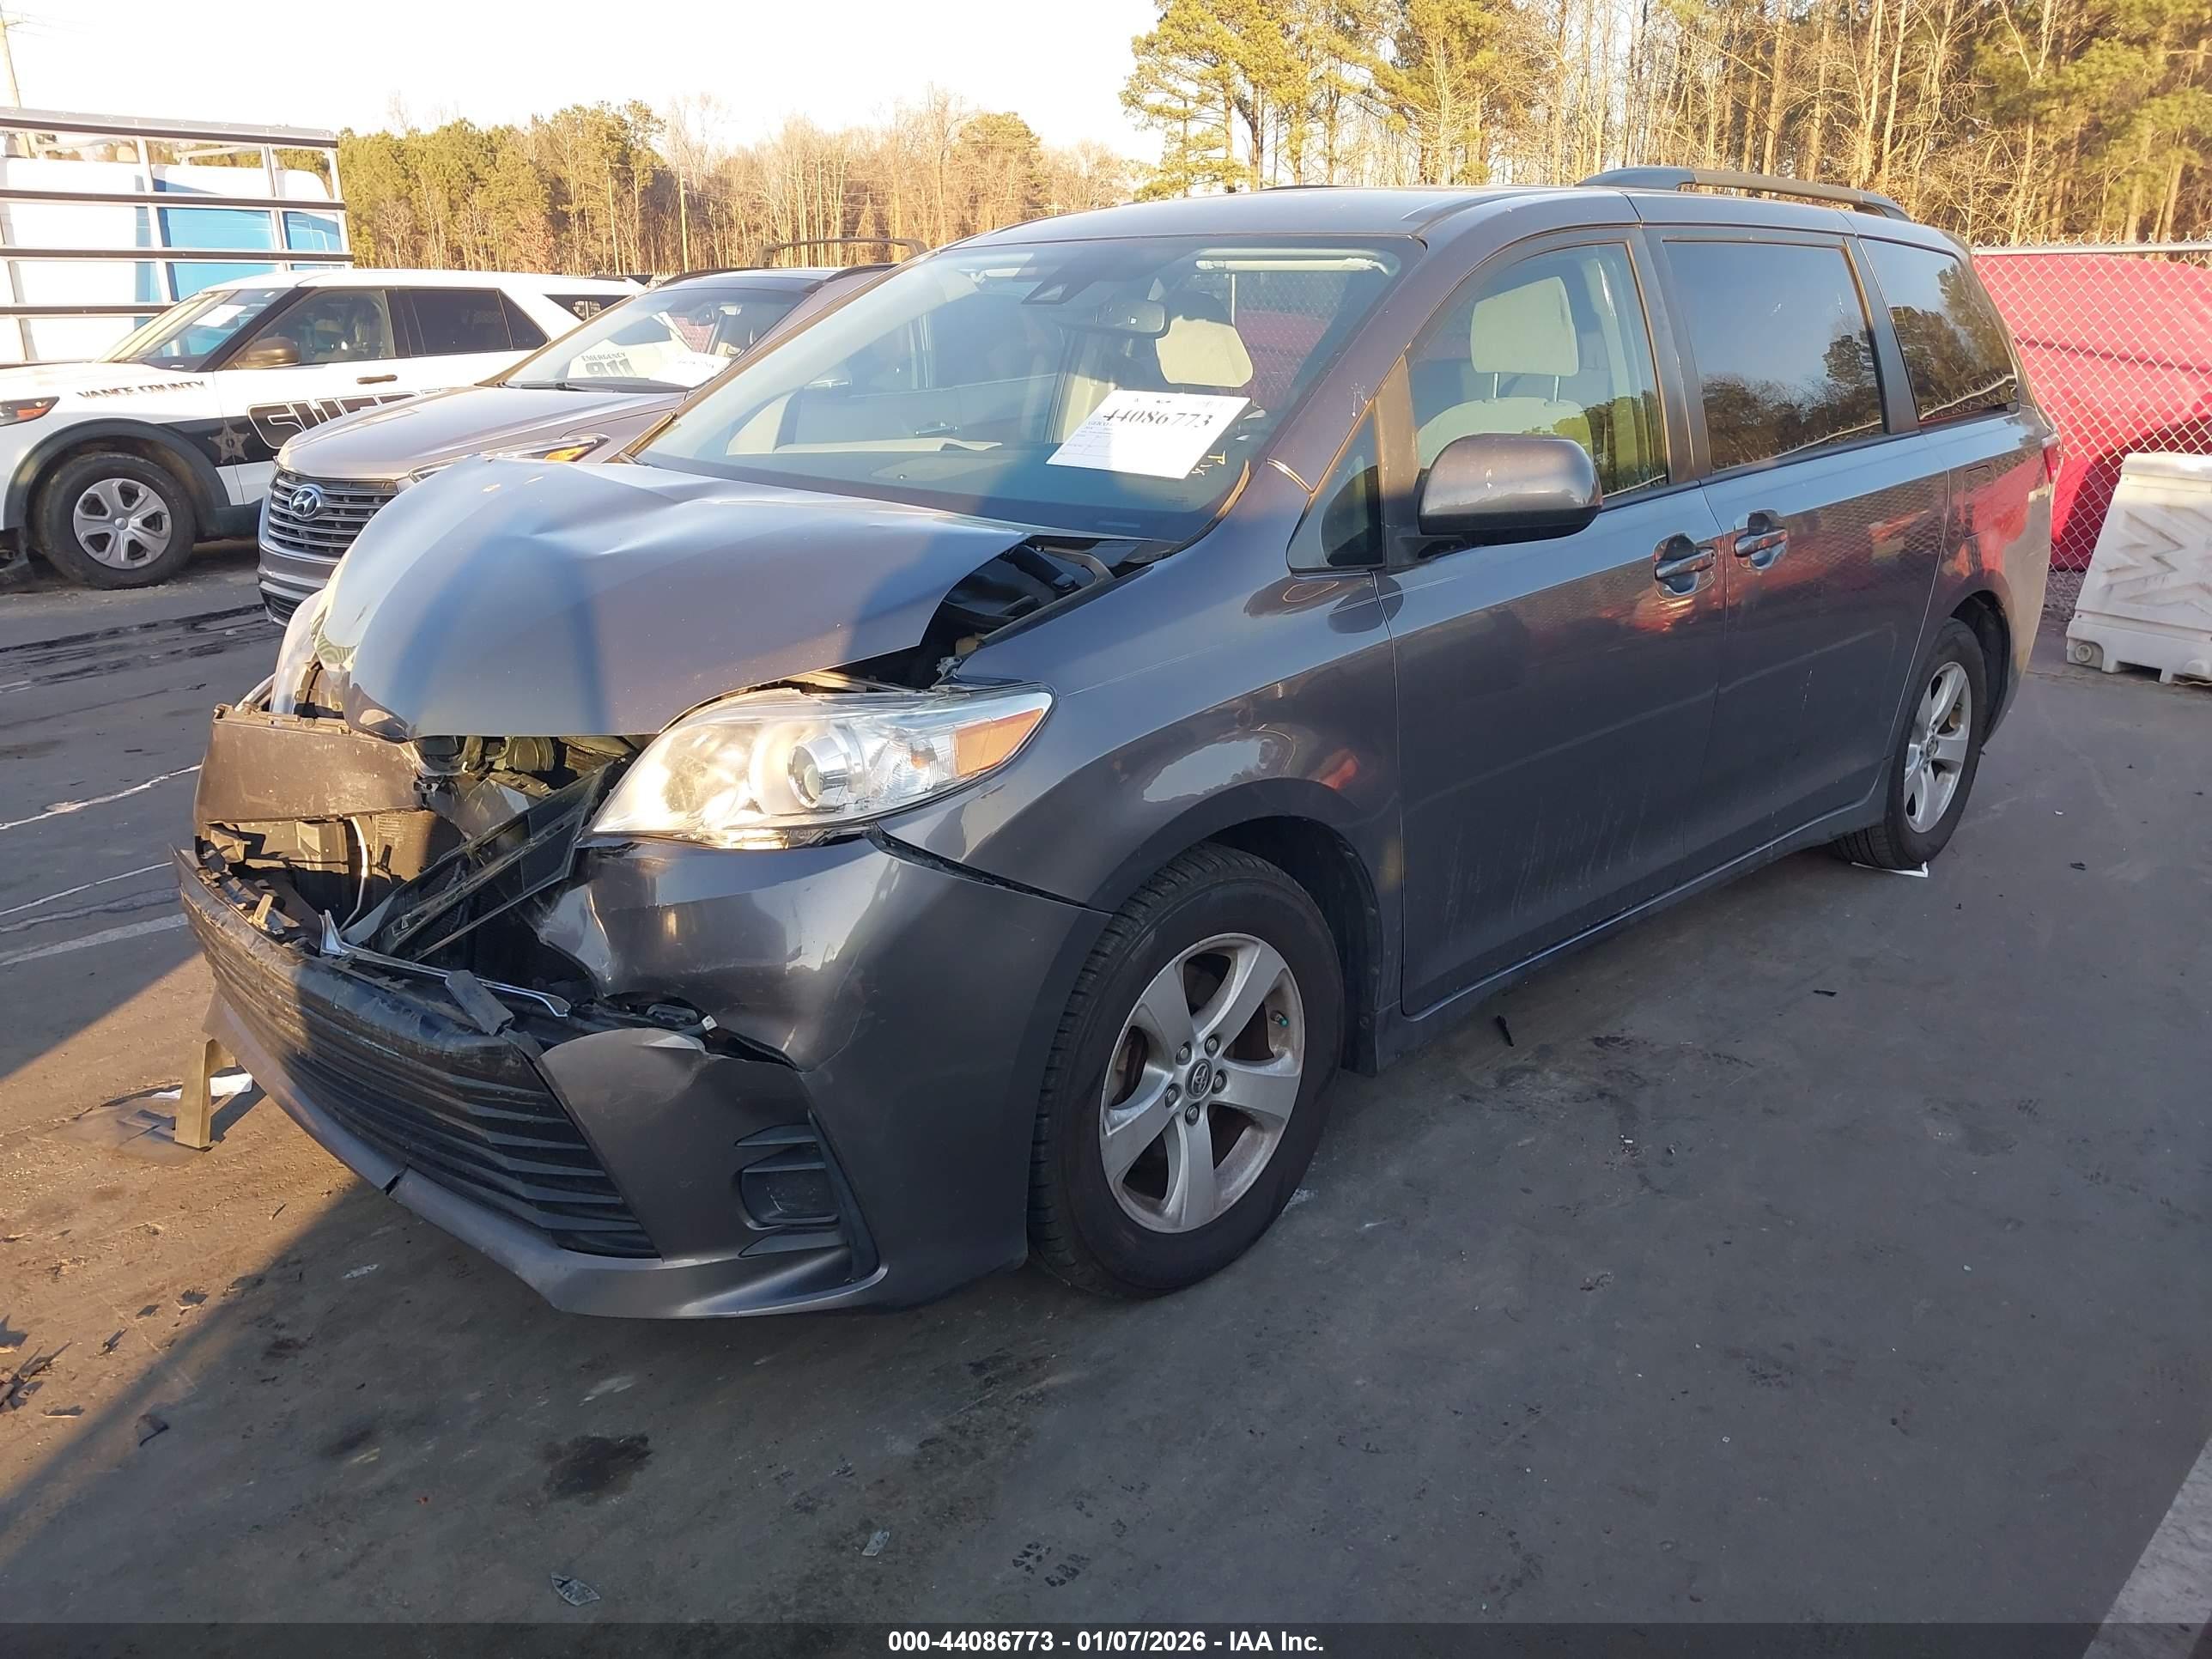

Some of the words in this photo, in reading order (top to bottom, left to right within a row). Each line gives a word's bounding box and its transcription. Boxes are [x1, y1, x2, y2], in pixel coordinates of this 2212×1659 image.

[585, 357, 636, 377] 911
[76, 387, 134, 398] VANCE
[138, 380, 206, 392] COUNTY
[1103, 409, 1213, 428] 44086773
